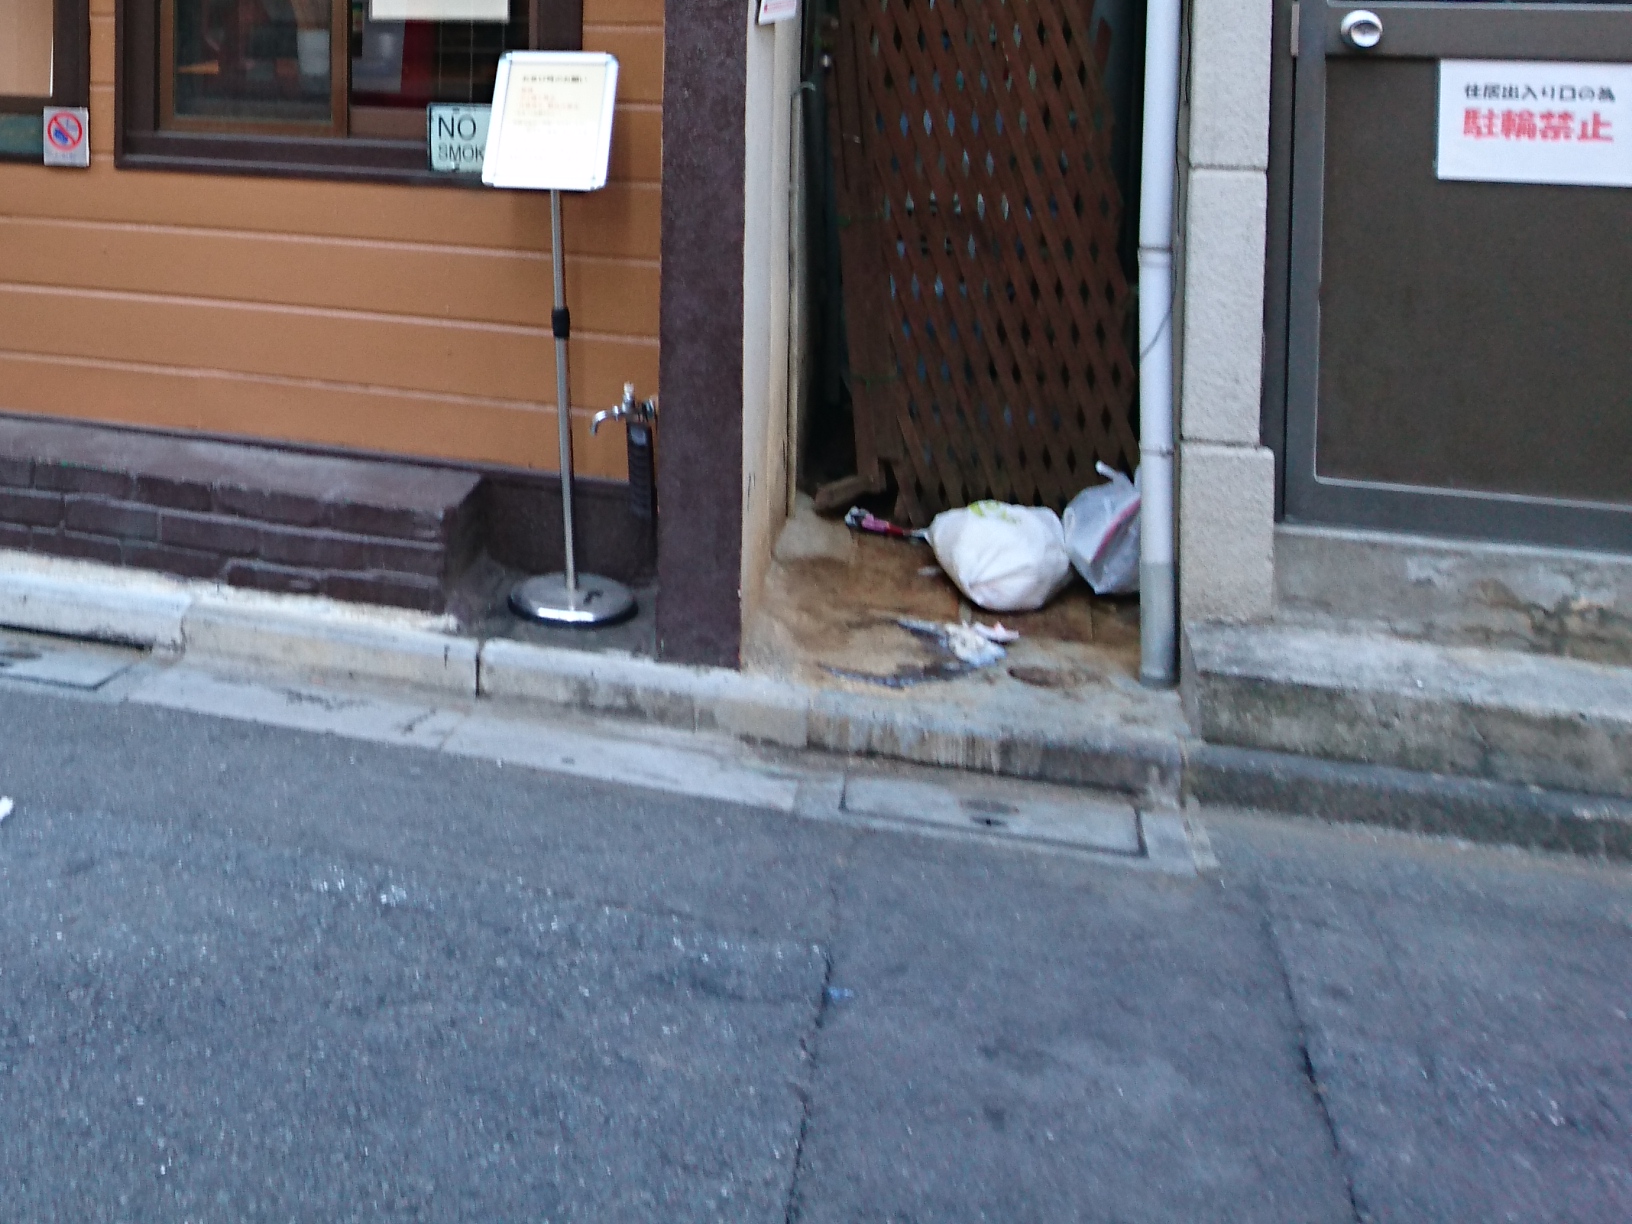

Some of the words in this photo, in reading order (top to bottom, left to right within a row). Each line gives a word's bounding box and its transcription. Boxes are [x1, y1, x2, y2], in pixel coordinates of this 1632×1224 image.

[437, 114, 477, 141] NO
[1463, 107, 1615, 144] 駐輪禁止
